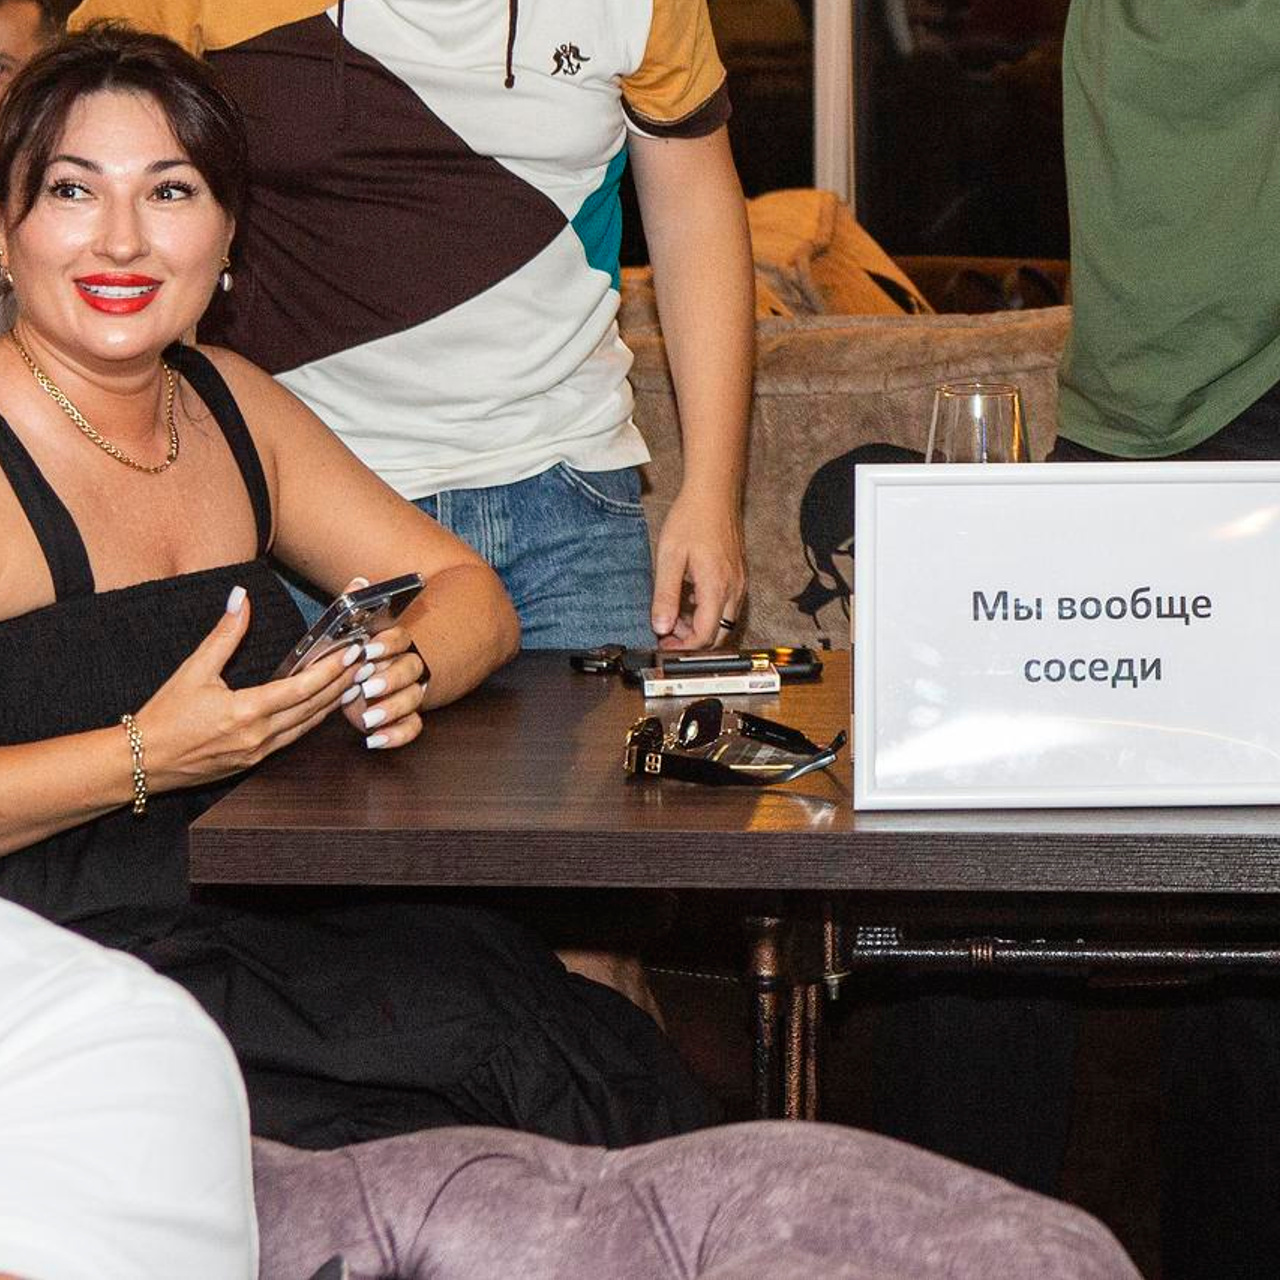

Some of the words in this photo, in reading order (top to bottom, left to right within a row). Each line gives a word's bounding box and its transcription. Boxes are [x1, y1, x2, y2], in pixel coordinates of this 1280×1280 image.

[972, 590, 1043, 622] Мы
[1057, 586, 1213, 626] вообще
[1024, 657, 1163, 689] соседи
